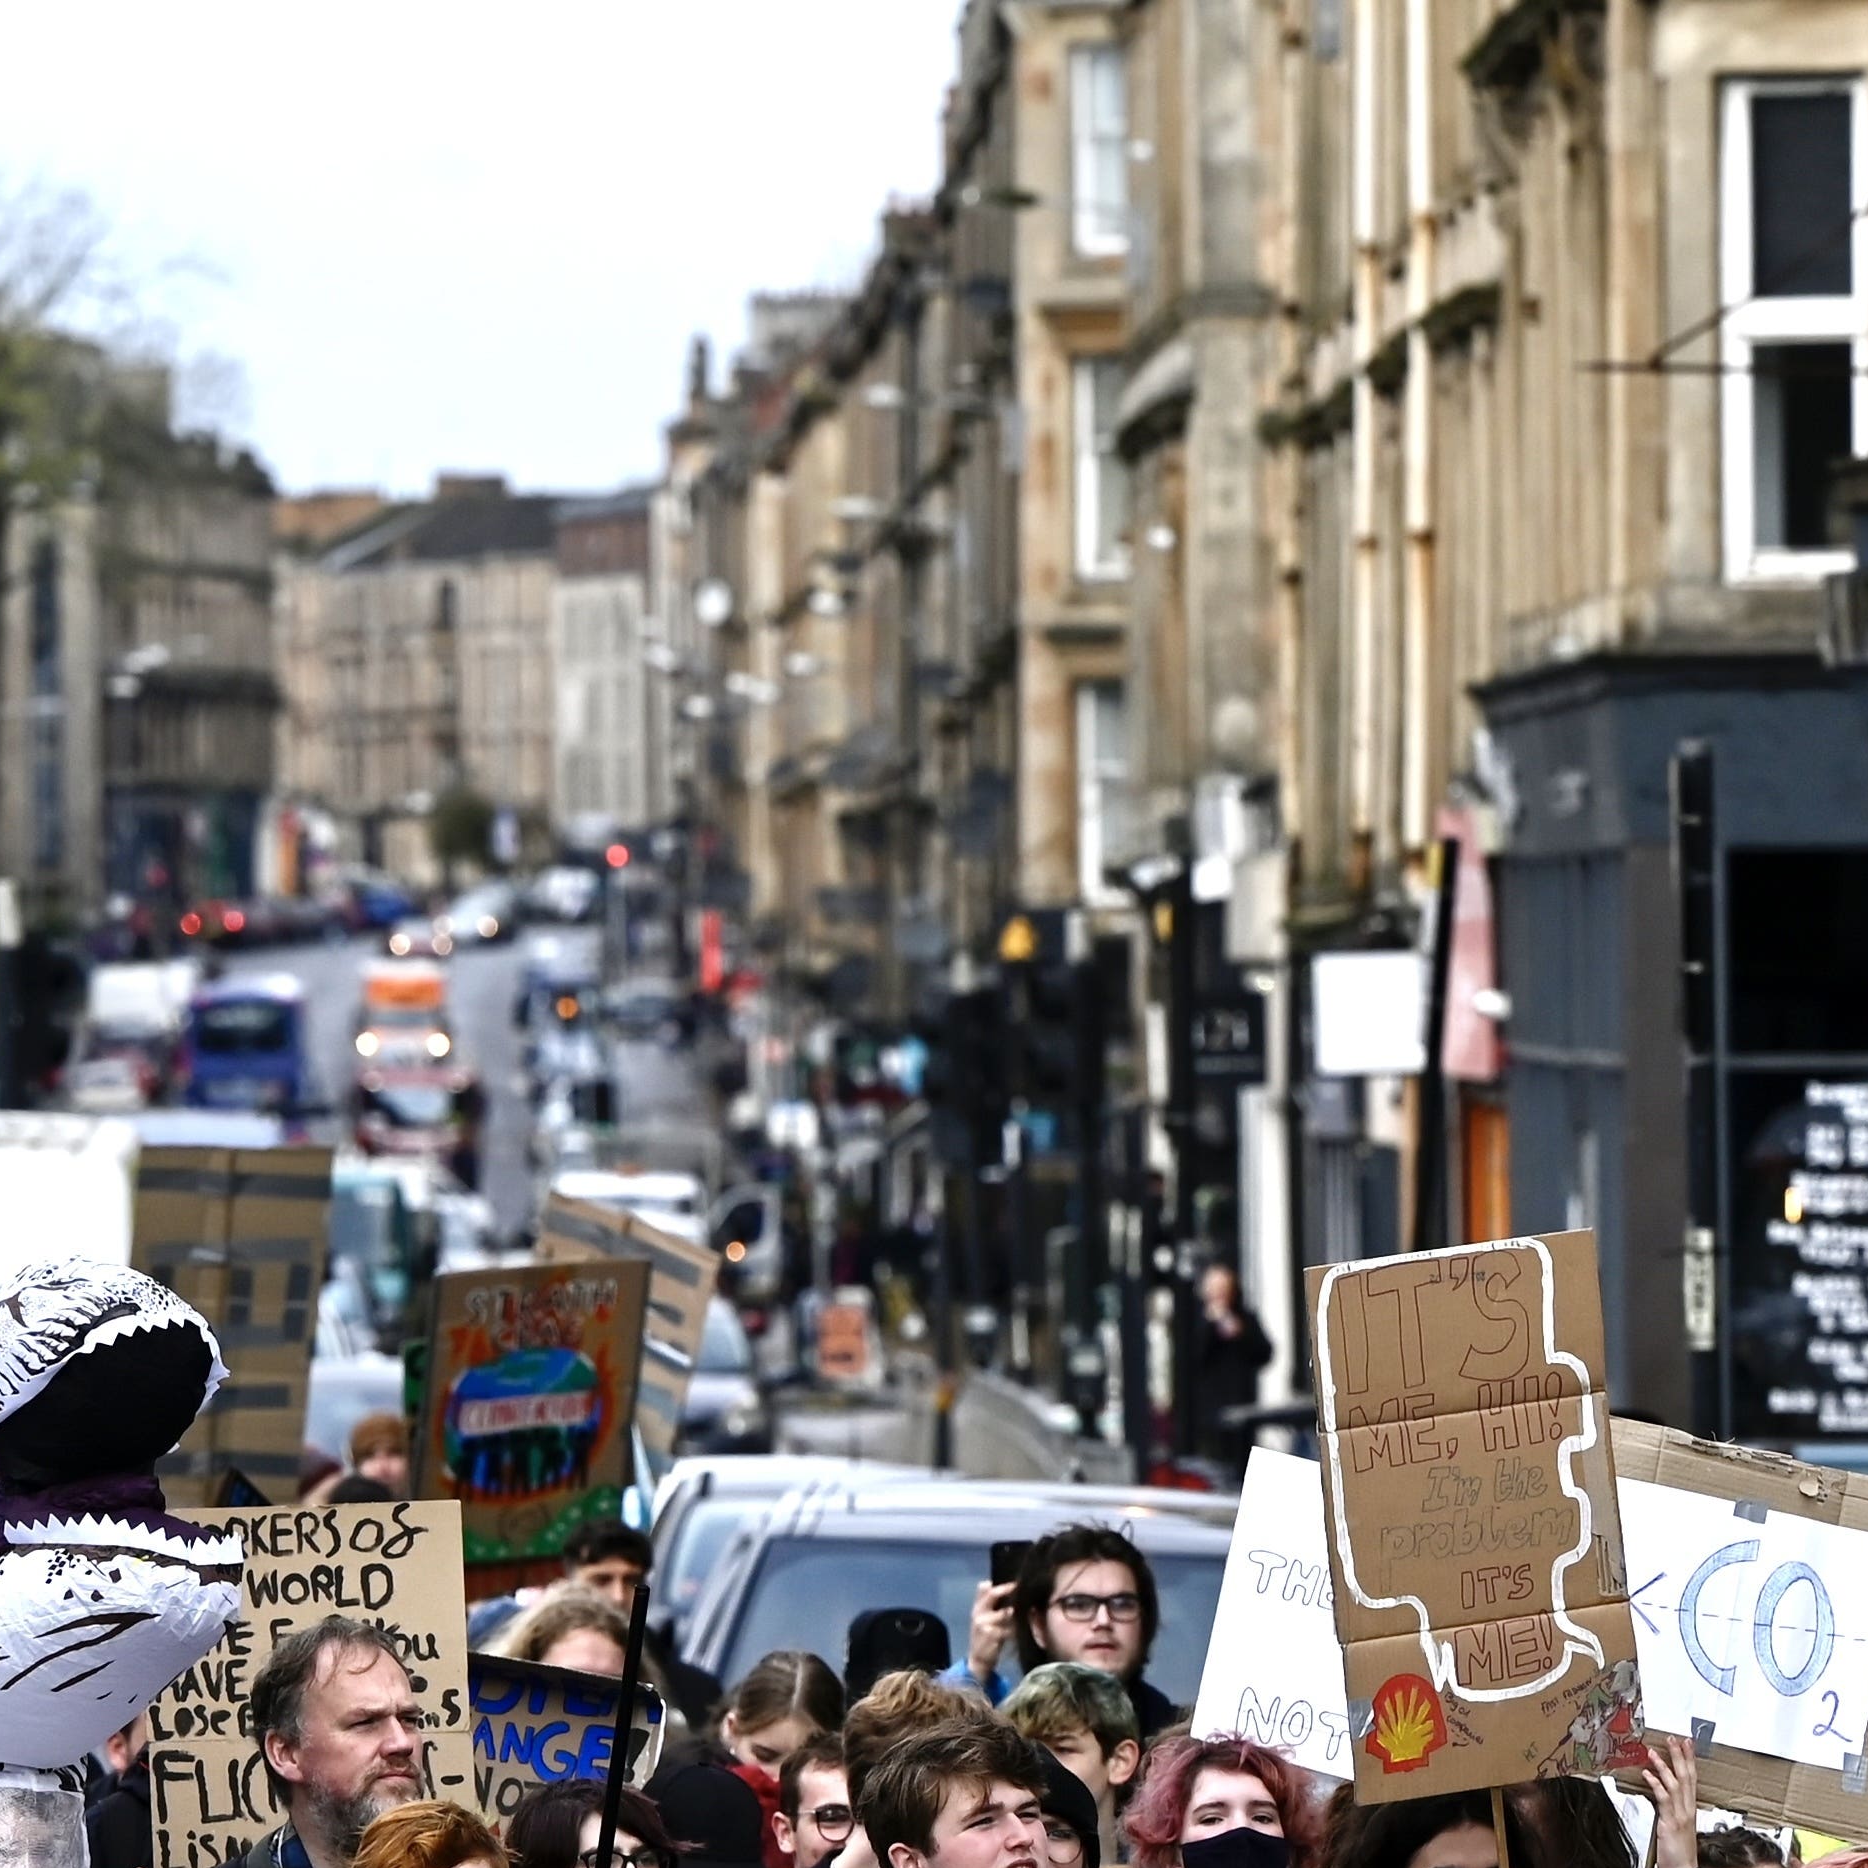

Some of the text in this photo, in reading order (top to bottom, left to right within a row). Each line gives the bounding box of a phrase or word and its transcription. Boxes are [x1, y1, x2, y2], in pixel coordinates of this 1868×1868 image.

[1337, 1251, 1531, 1395] IT'S
[1348, 1371, 1563, 1475] ME, HI!
[1422, 1456, 1548, 1513] I'm the
[246, 1563, 395, 1612] WORLD
[1380, 1508, 1575, 1594] problem
[1460, 1563, 1534, 1610] IT'S
[1454, 1608, 1554, 1687] ME!
